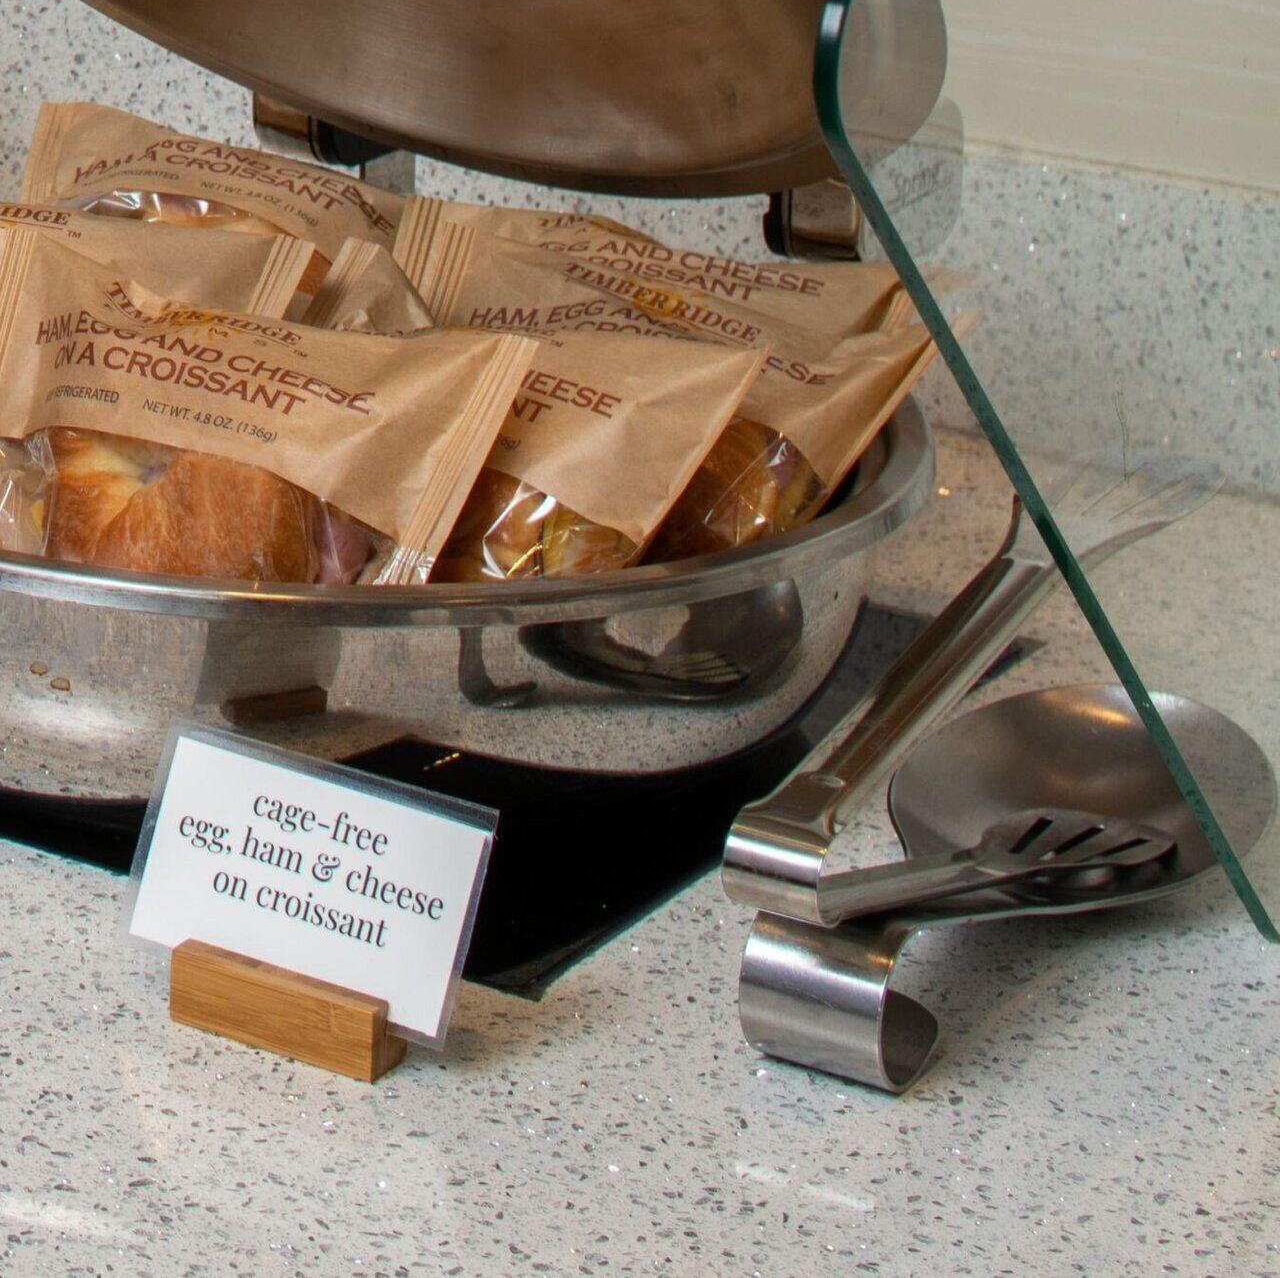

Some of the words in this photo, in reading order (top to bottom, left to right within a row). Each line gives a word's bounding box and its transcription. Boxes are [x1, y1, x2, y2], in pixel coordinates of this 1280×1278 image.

[165, 154, 345, 210] CROISSANT
[595, 239, 675, 263] AND
[679, 251, 826, 298] CHEESE
[469, 306, 540, 328] HAM,
[545, 299, 608, 325] EGG
[671, 298, 762, 343] RIDGE
[76, 341, 96, 367] A
[102, 345, 307, 415] CROISSANT
[141, 333, 224, 364] AND
[227, 354, 376, 416] CHEESE
[142, 398, 170, 415] NET
[168, 405, 191, 422] WT.
[192, 410, 212, 426] 4.8
[236, 421, 279, 443] (136g)
[252, 794, 389, 856] cage-free
[178, 814, 233, 856] egg,
[239, 826, 303, 875] ham
[311, 852, 341, 882] &
[345, 865, 445, 921] cheese
[212, 870, 248, 902] on
[255, 884, 389, 948] croissant
